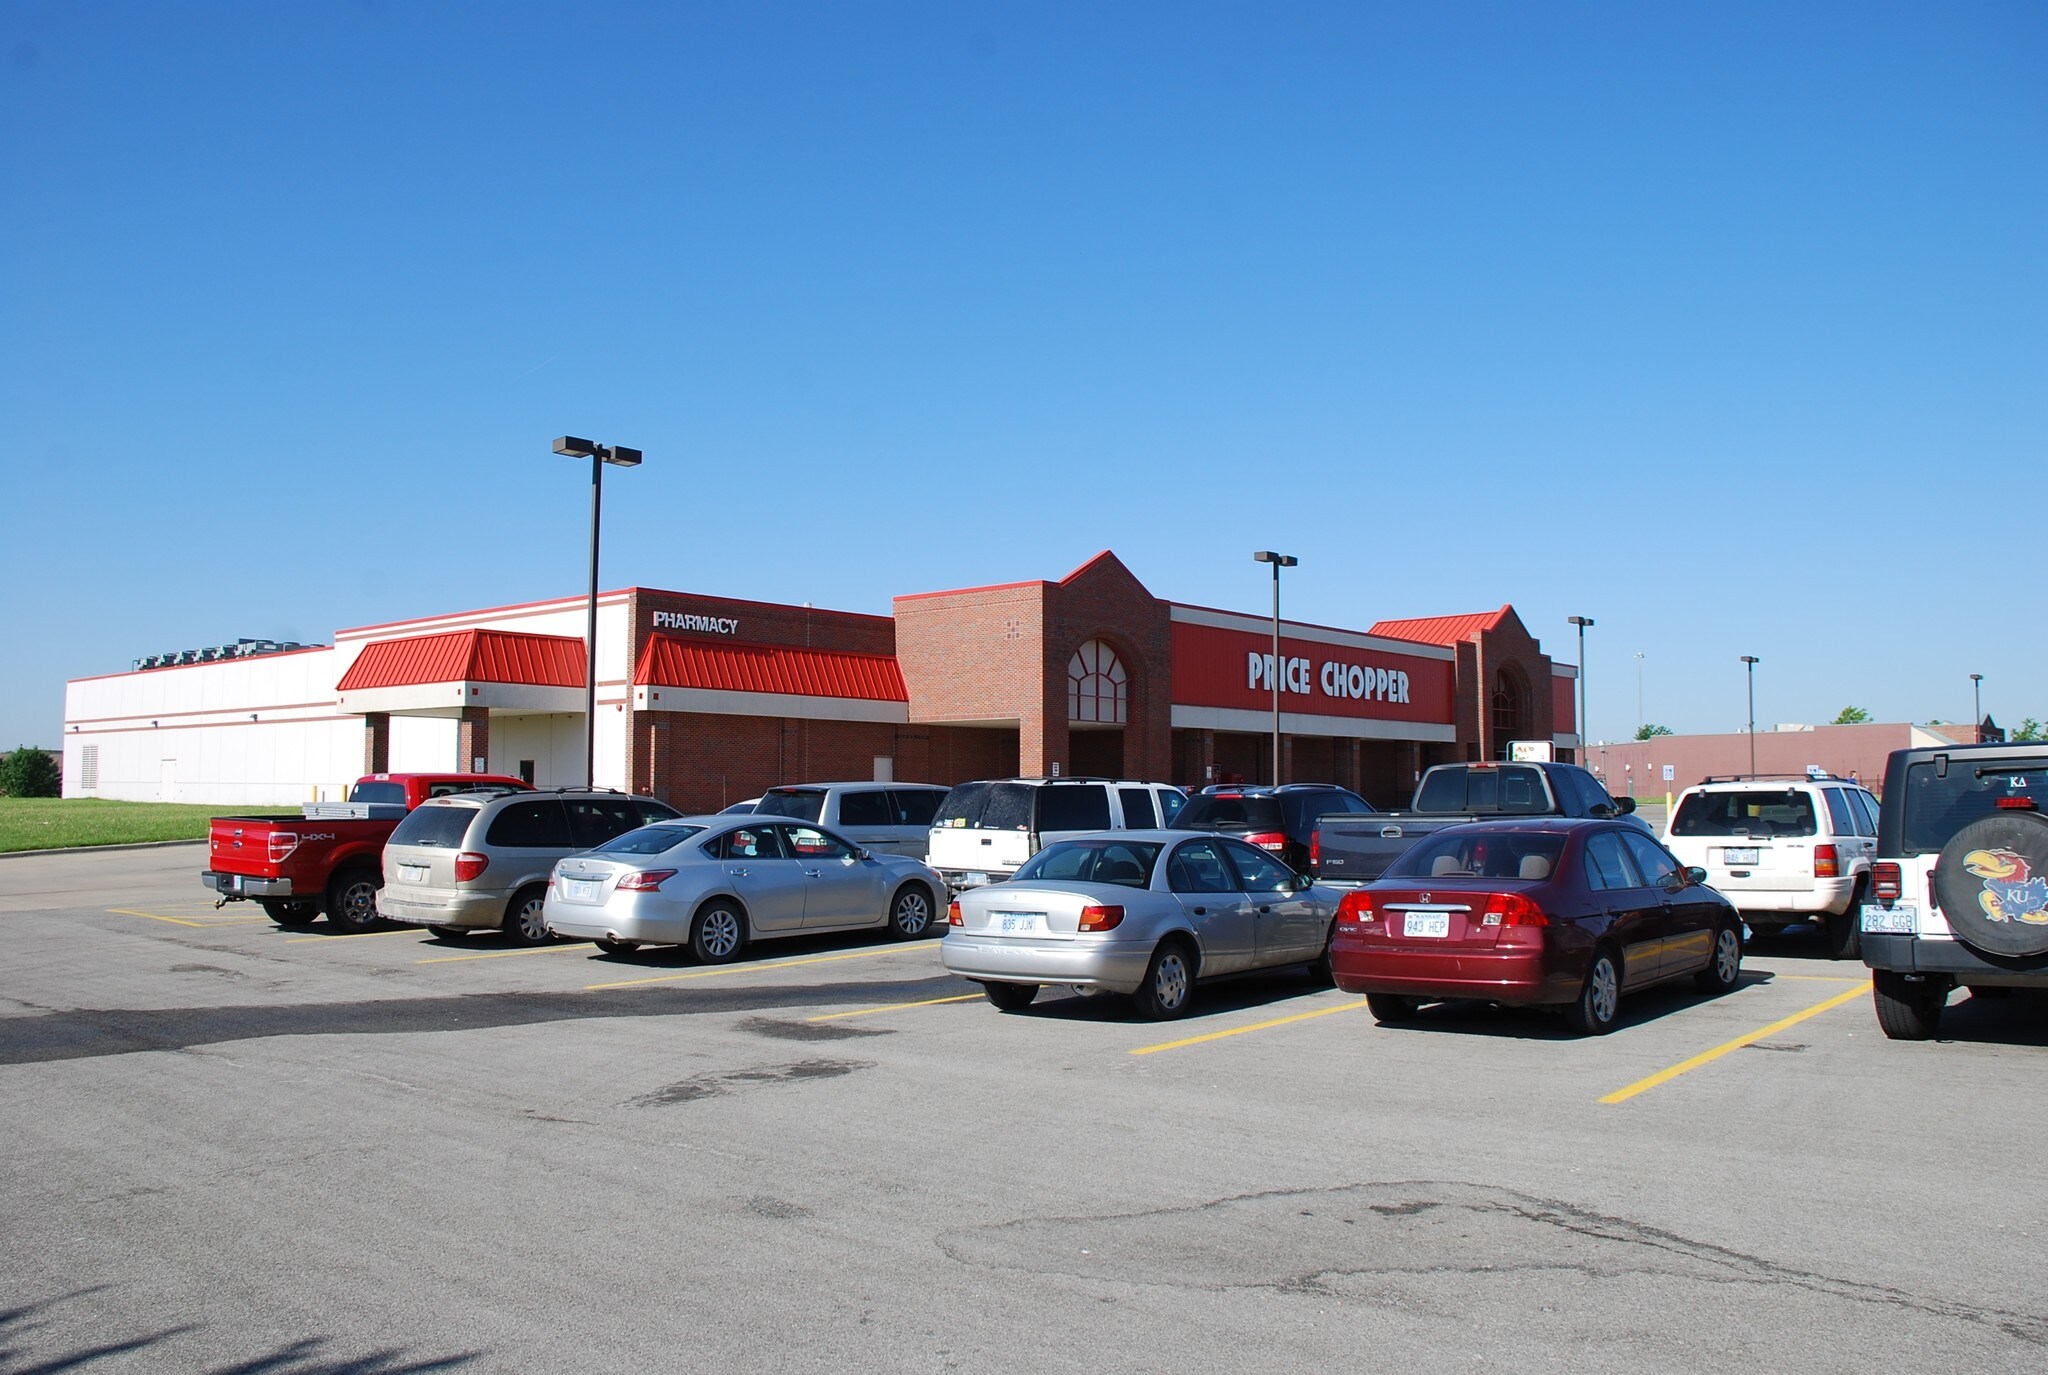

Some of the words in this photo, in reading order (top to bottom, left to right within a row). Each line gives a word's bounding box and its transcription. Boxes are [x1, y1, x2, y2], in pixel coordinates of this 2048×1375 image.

[653, 611, 738, 634] PHARMACY
[1249, 652, 1311, 694] PRICE
[1321, 661, 1410, 704] CHOPPER
[2007, 889, 2029, 903] KU
[1407, 920, 1424, 933] 943
[1428, 920, 1446, 933] HEP
[1865, 914, 1885, 928] 282
